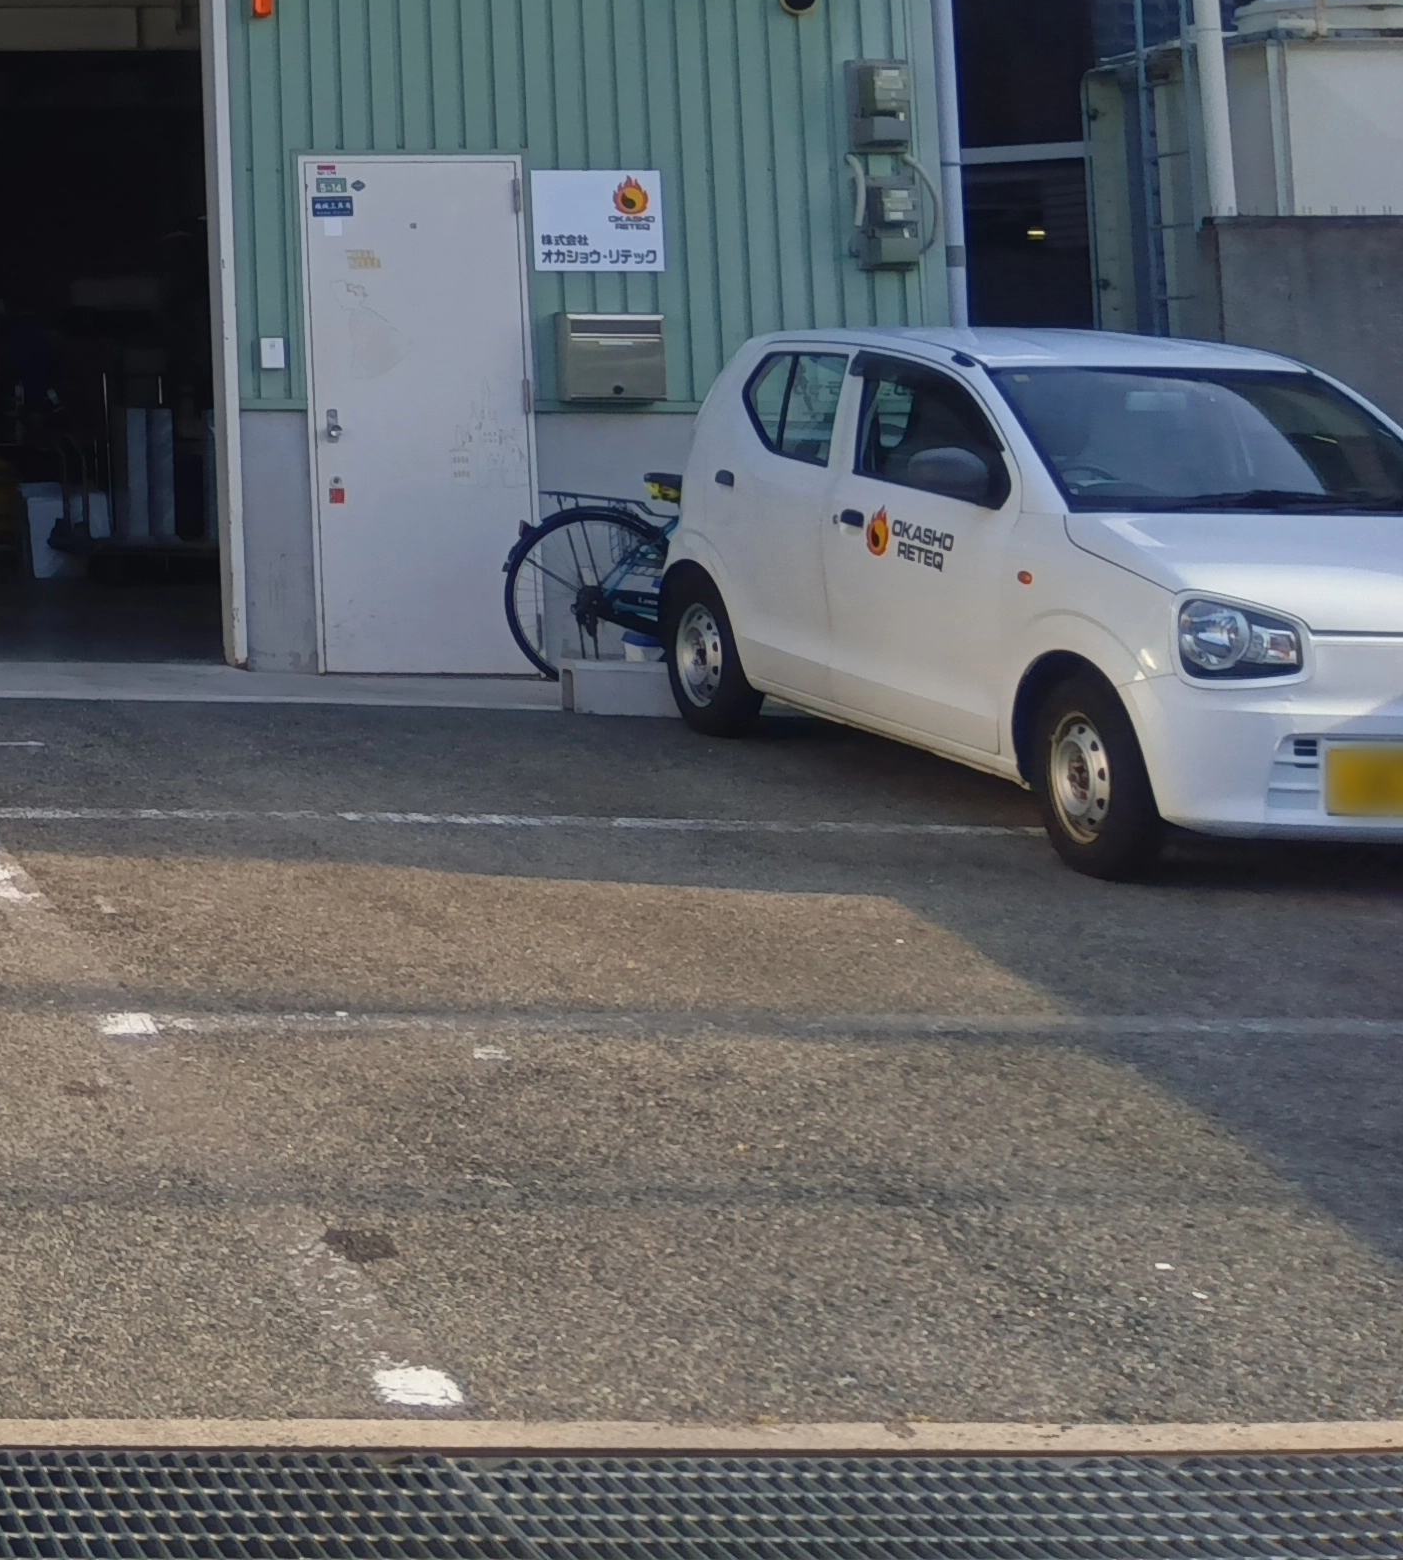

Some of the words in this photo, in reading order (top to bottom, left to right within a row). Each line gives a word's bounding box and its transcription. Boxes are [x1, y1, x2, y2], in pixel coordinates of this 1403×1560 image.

[608, 215, 655, 223] OKASHO
[615, 223, 651, 231] RETEQ
[541, 234, 590, 247] 株式会社
[541, 248, 658, 265] オカショウ・リテック
[892, 519, 955, 552] OKASHO
[897, 541, 944, 572] RETEQ
